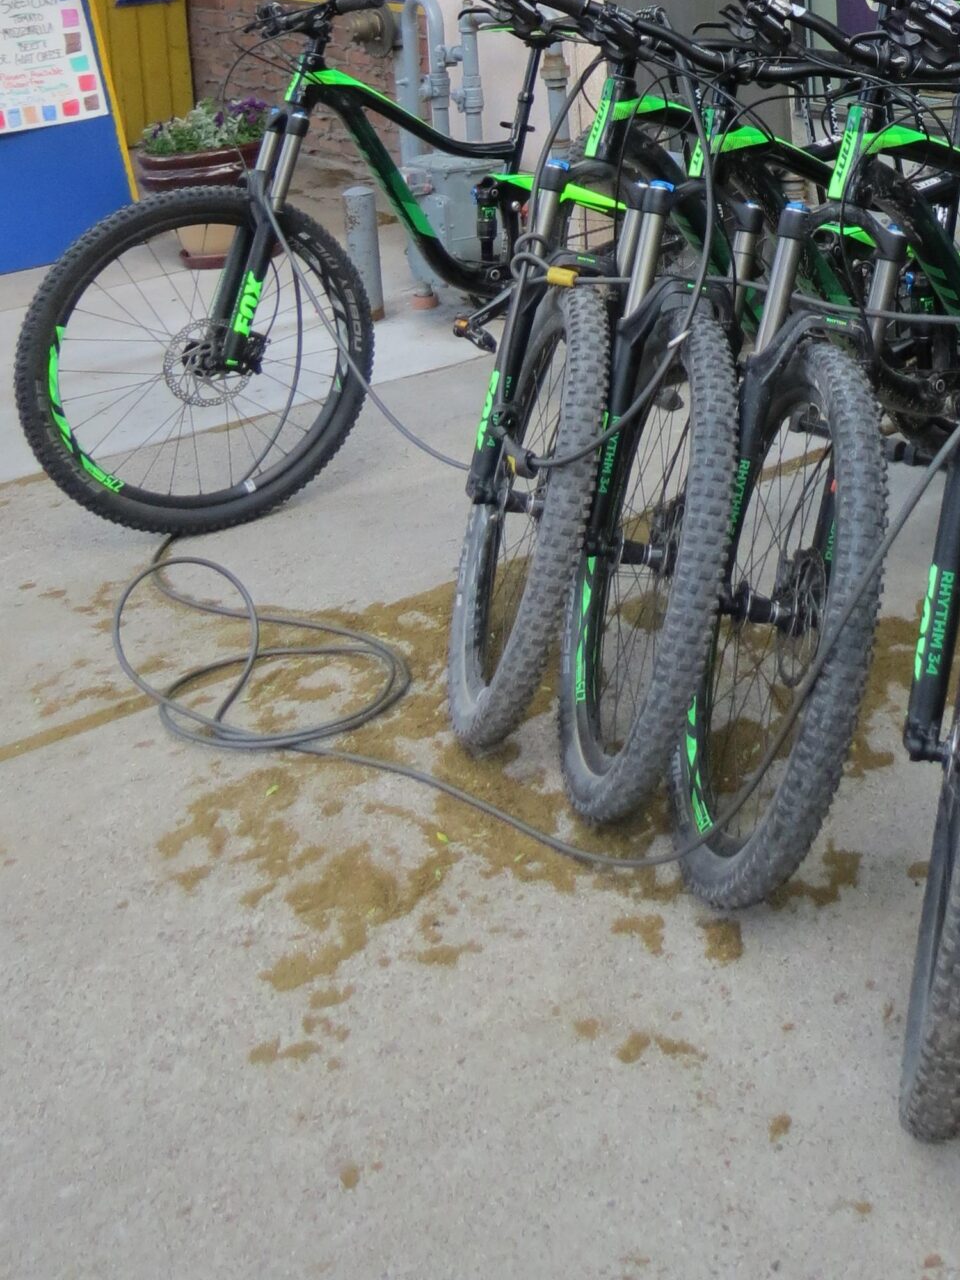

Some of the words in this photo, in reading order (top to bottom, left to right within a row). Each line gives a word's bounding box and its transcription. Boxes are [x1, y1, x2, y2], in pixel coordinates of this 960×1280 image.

[234, 270, 264, 338] FOX
[930, 570, 956, 650] RHYTHM
[925, 652, 942, 676] 34
